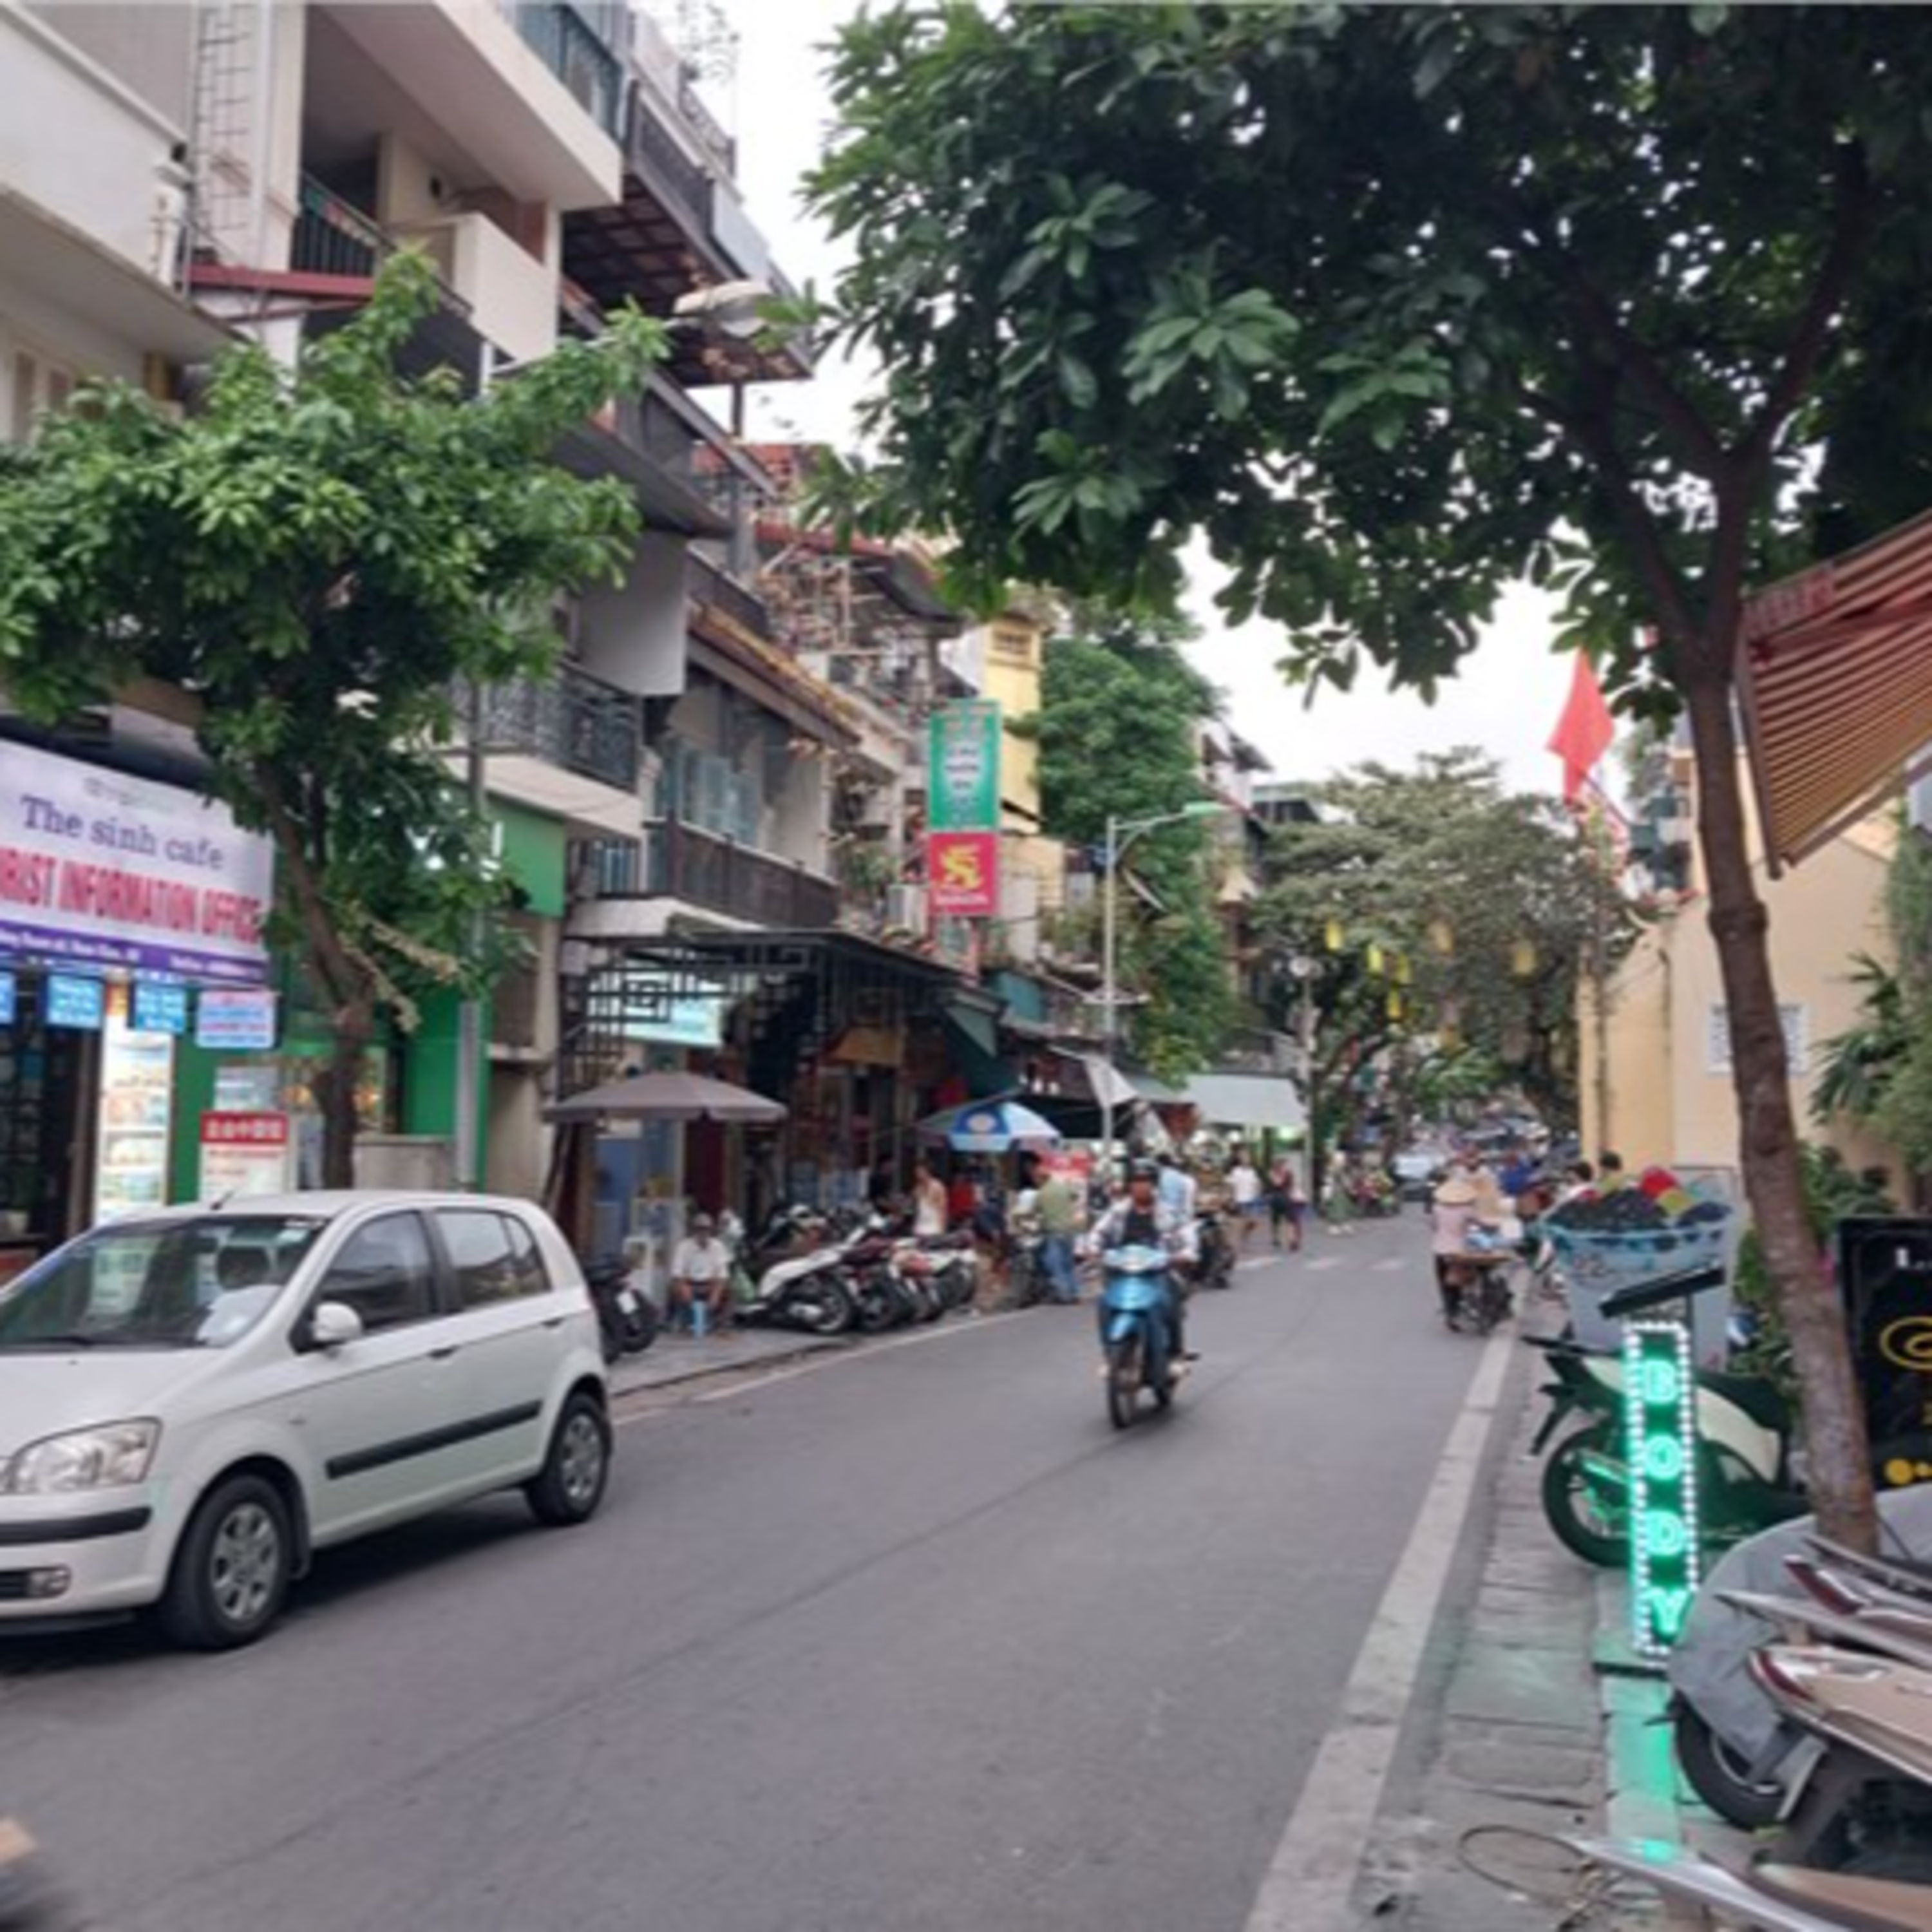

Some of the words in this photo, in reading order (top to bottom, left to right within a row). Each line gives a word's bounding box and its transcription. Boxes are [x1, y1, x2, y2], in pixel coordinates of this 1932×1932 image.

[21, 795, 82, 837] The
[90, 816, 156, 856] sinh
[166, 832, 223, 869] cafe
[1642, 1358, 1692, 1639] BODY
